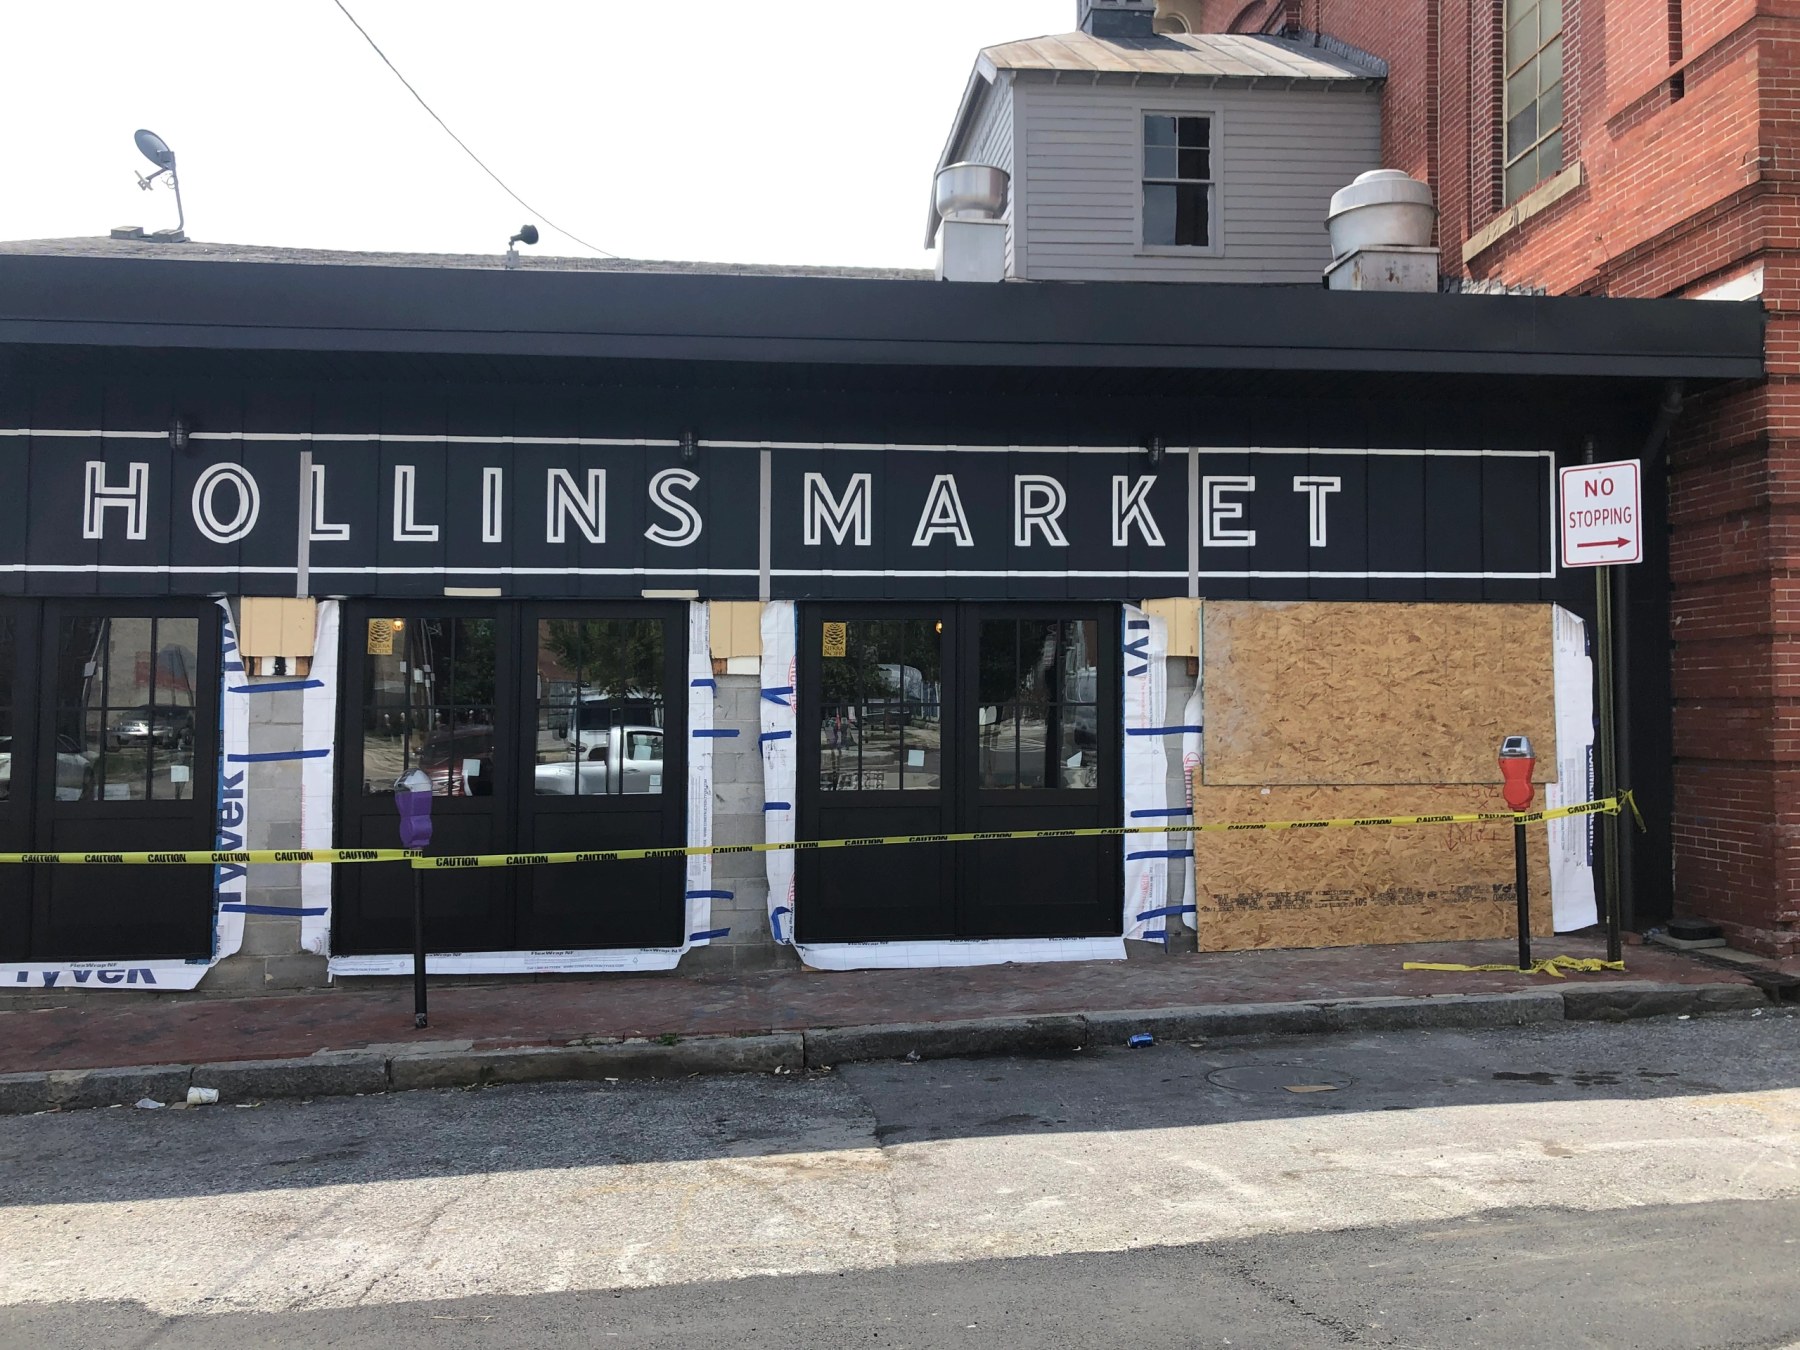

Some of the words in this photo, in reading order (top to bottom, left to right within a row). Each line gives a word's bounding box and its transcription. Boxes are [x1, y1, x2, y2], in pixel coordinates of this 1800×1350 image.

[1585, 478, 1614, 497] NO
[82, 460, 702, 547] HOLLINS
[803, 472, 1341, 547] MARKET
[1569, 506, 1632, 528] STOPPING
[1567, 800, 1606, 814] CAUTION
[22, 855, 60, 863] CAUTION
[85, 854, 123, 863] CAUTION
[148, 853, 187, 863] CAUTION
[211, 853, 250, 862] CAUTION
[274, 852, 314, 861] CAUTION
[338, 851, 378, 860] CAUTION
[436, 857, 479, 867] CAUTION
[506, 855, 549, 865] CAUTION
[576, 853, 618, 862] CAUTION
[644, 849, 686, 859] CAUTION
[712, 846, 753, 854] CAUTION
